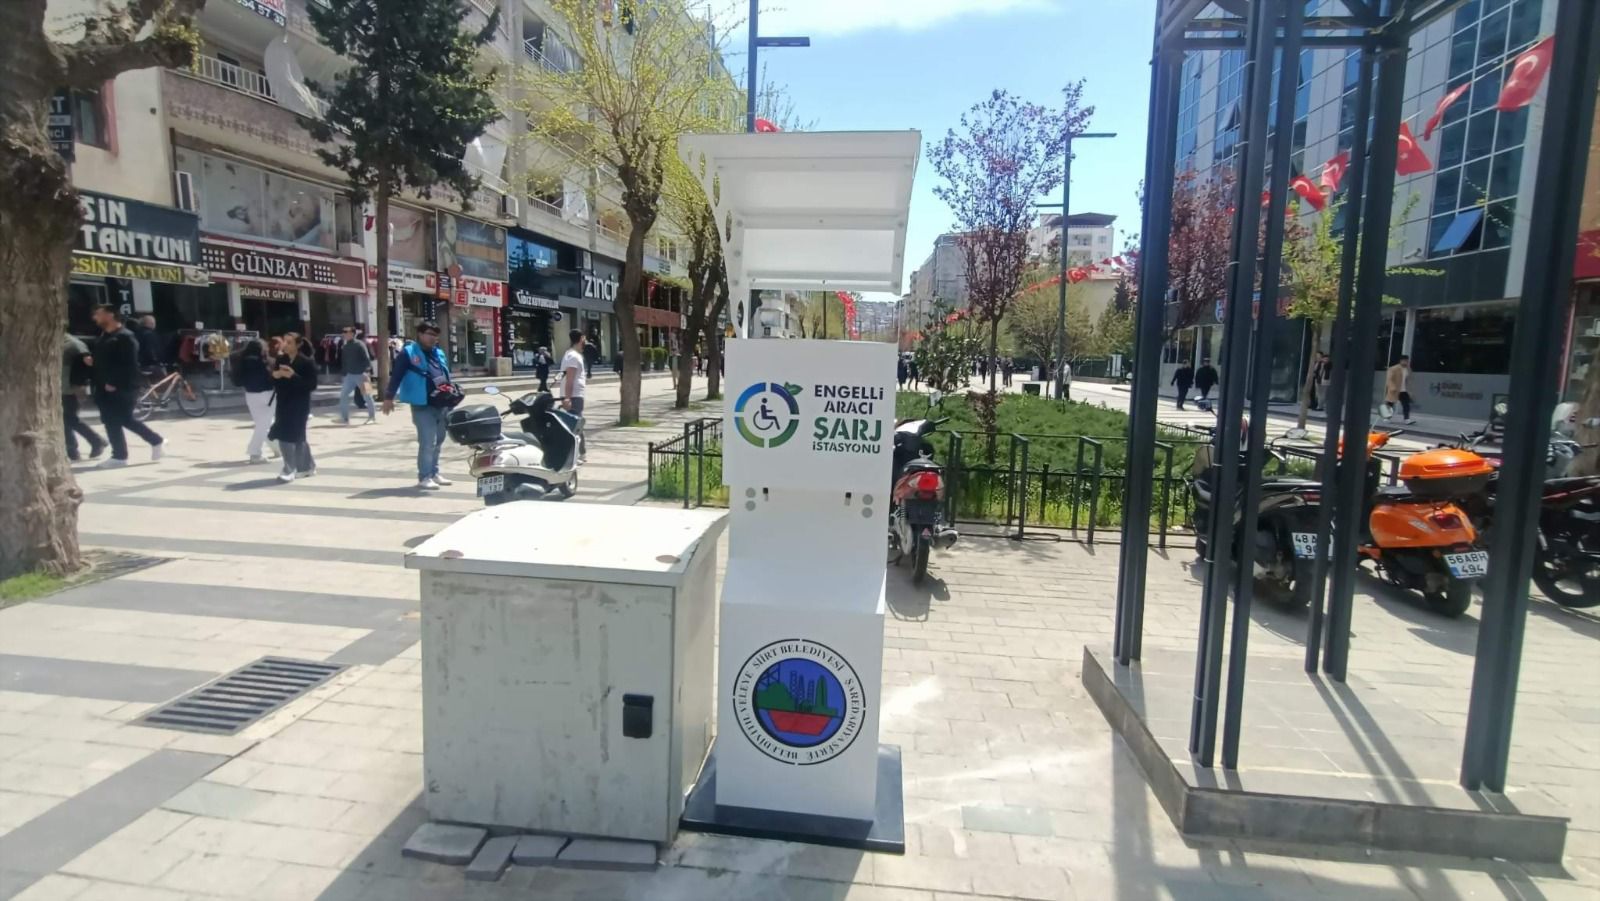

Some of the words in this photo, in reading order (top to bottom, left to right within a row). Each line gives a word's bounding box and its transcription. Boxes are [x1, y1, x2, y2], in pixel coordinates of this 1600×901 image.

[80, 224, 192, 262] TANTUNİ
[231, 251, 310, 279] GÜNBAT
[823, 400, 873, 415] ARACI
[813, 416, 882, 442] ŞARJ
[1295, 534, 1309, 543] 48
[1461, 564, 1484, 573] 494
